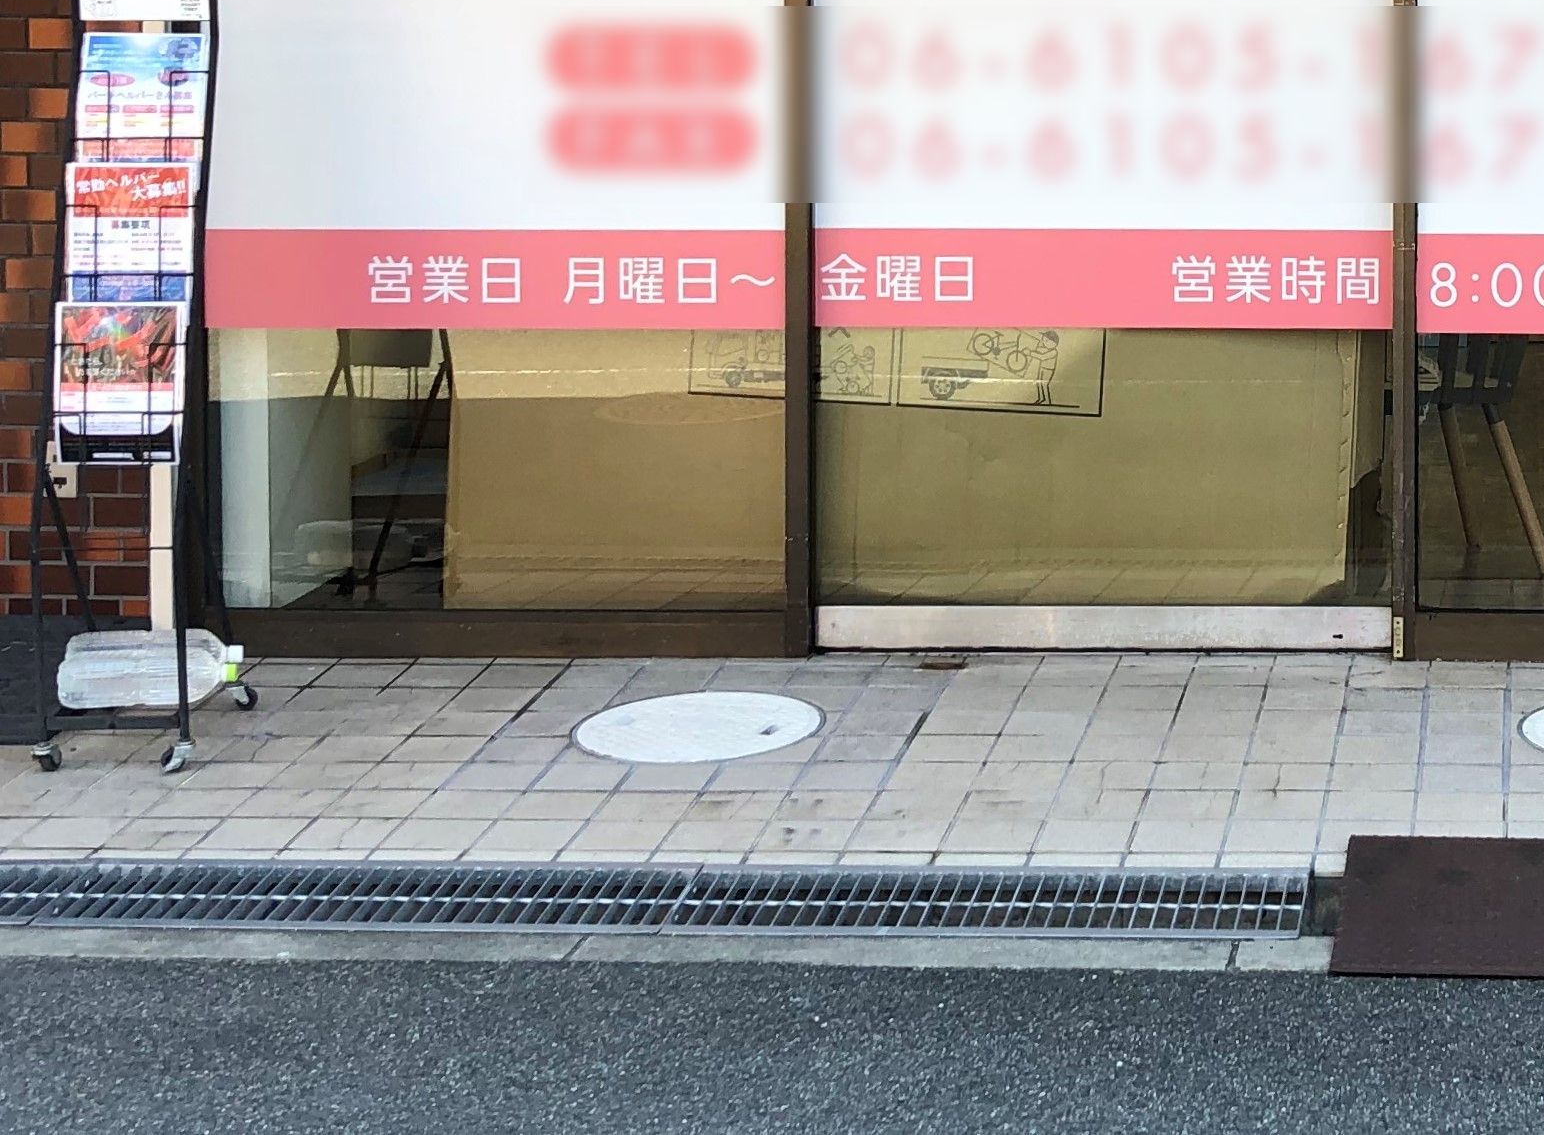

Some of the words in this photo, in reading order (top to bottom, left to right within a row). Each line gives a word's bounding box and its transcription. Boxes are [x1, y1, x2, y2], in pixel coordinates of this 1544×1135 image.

[367, 255, 522, 305] 営業日
[819, 252, 975, 303] 金曜日
[1170, 254, 1381, 306] 営業時間
